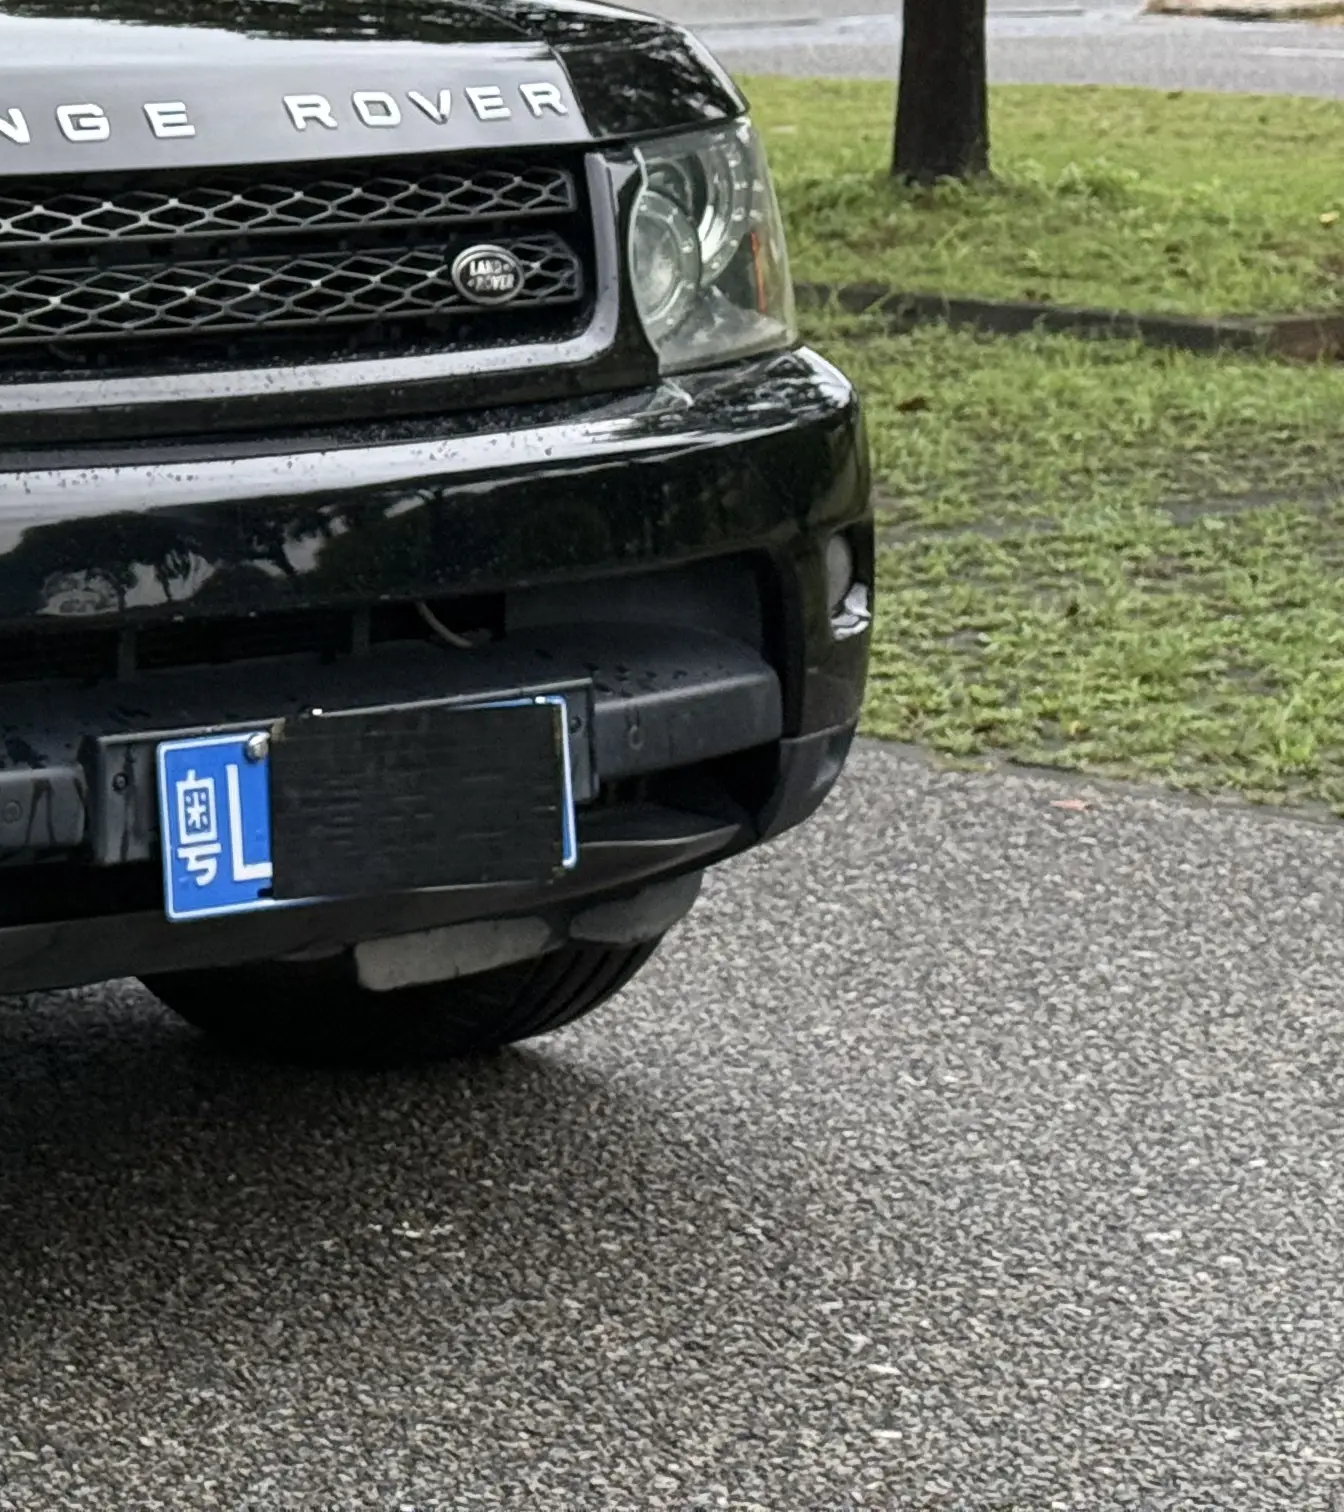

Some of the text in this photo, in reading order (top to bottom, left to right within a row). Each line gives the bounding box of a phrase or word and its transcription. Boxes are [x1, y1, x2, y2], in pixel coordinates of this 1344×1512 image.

[282, 82, 568, 130] ROVER
[469, 259, 502, 276] LAND
[475, 273, 515, 292] ROVER
